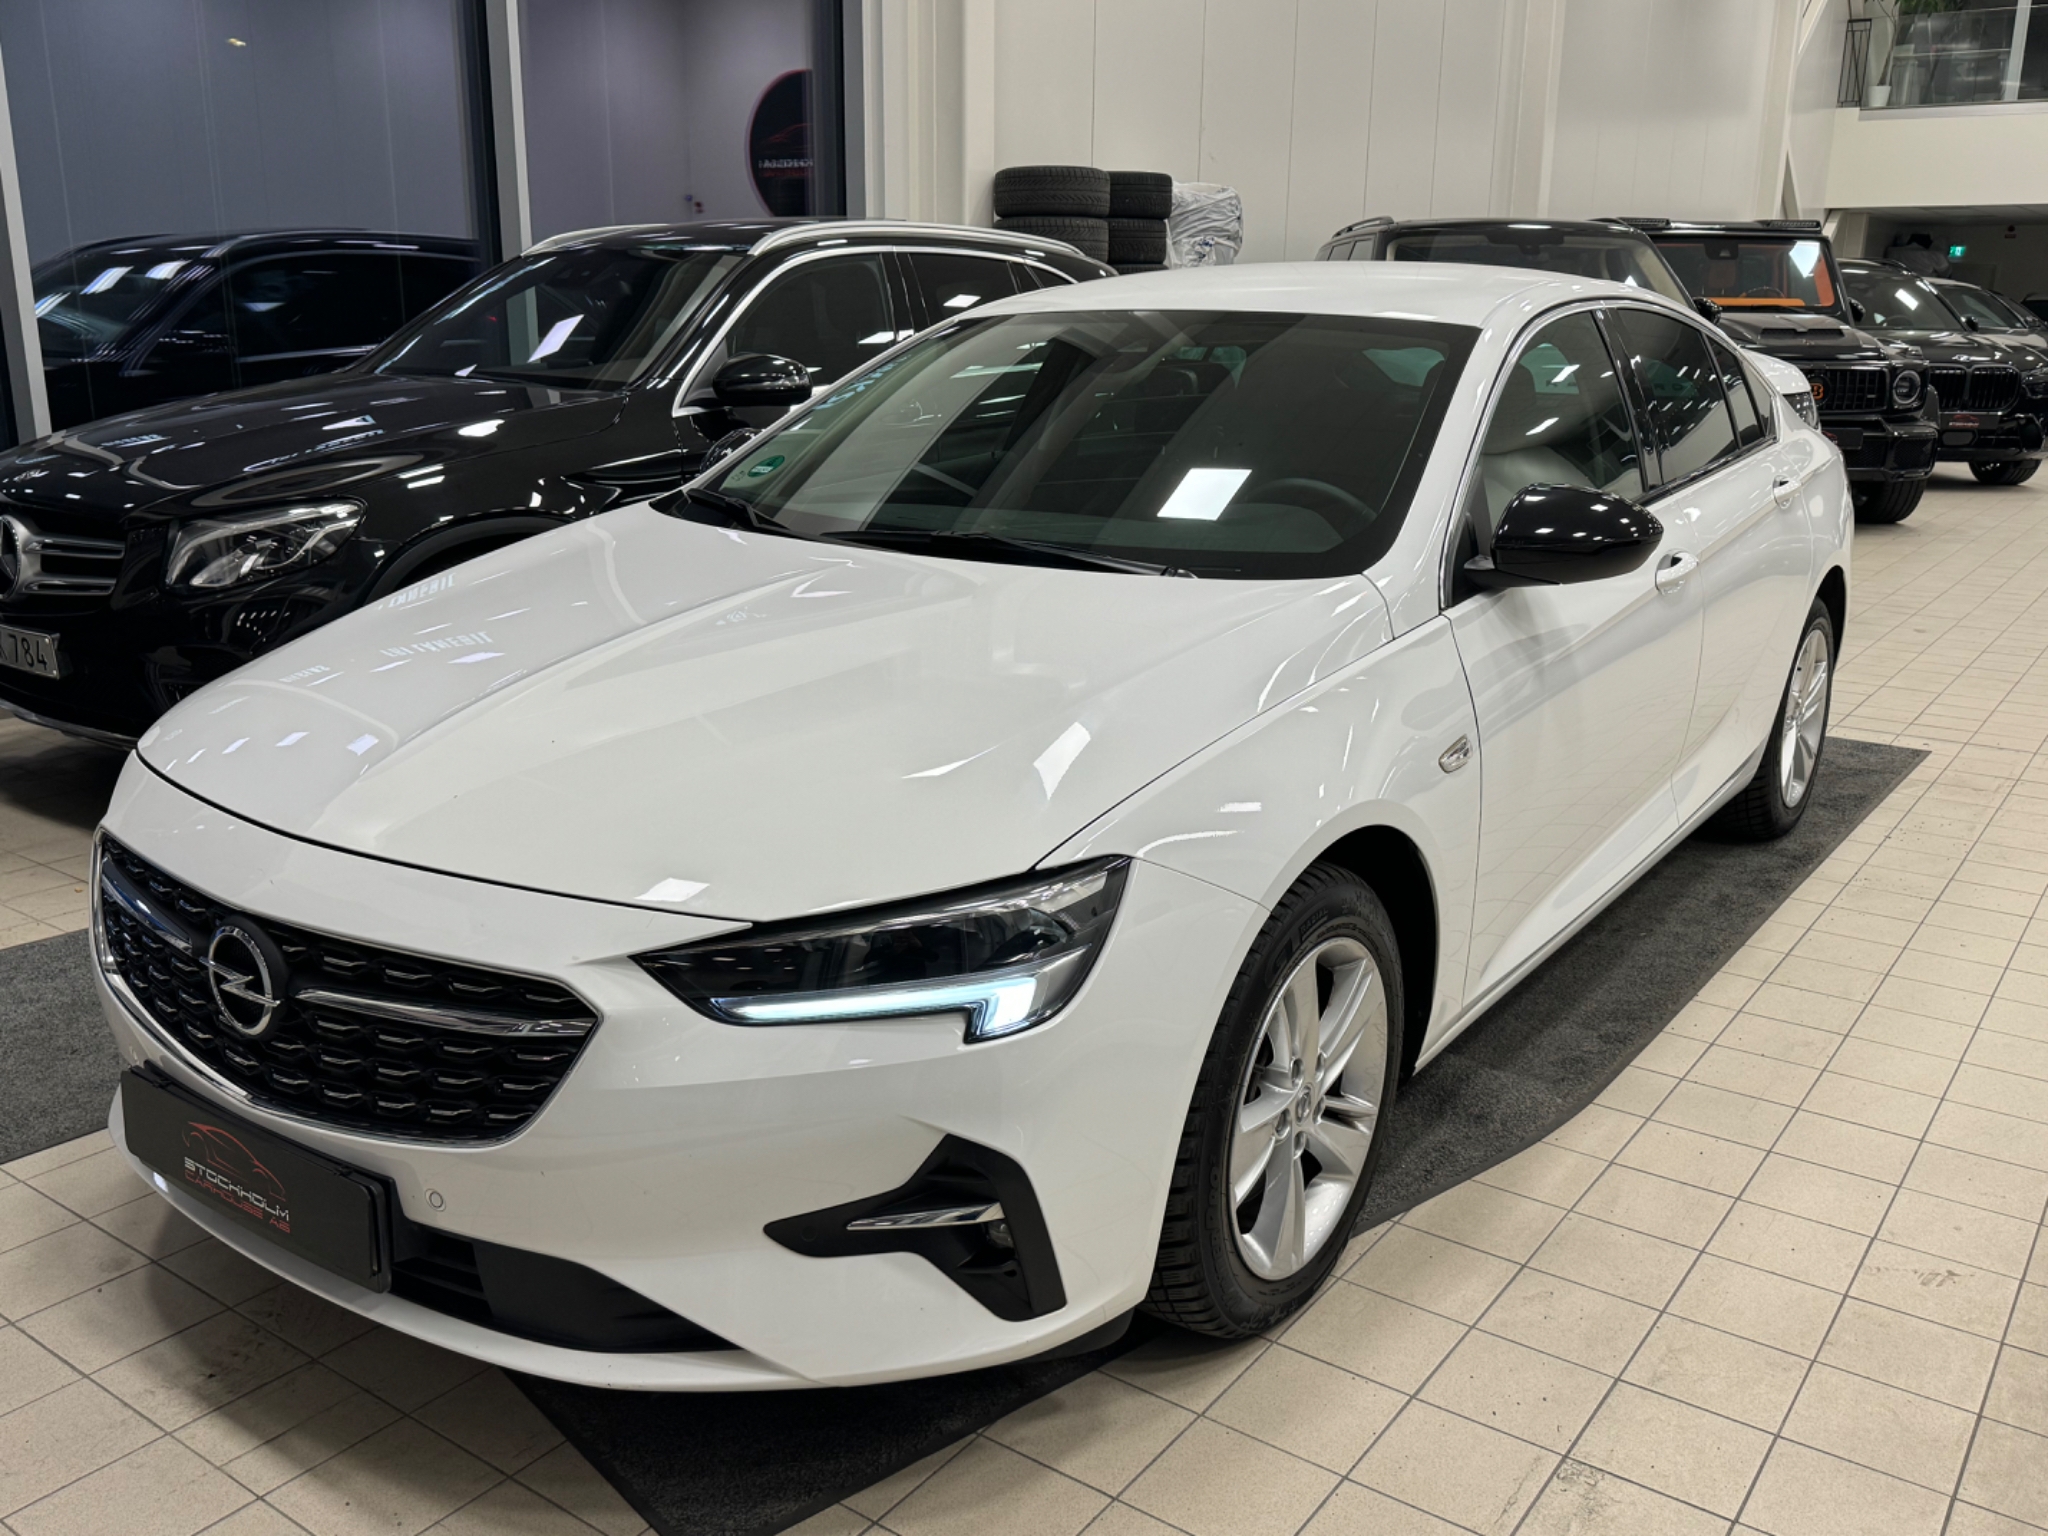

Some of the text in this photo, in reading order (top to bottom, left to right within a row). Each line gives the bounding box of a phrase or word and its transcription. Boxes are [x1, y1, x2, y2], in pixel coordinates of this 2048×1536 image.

[8, 633, 48, 671] 784
[184, 1156, 290, 1222] STOCKHOLM
[184, 1169, 291, 1234] CARHOUSE AB
